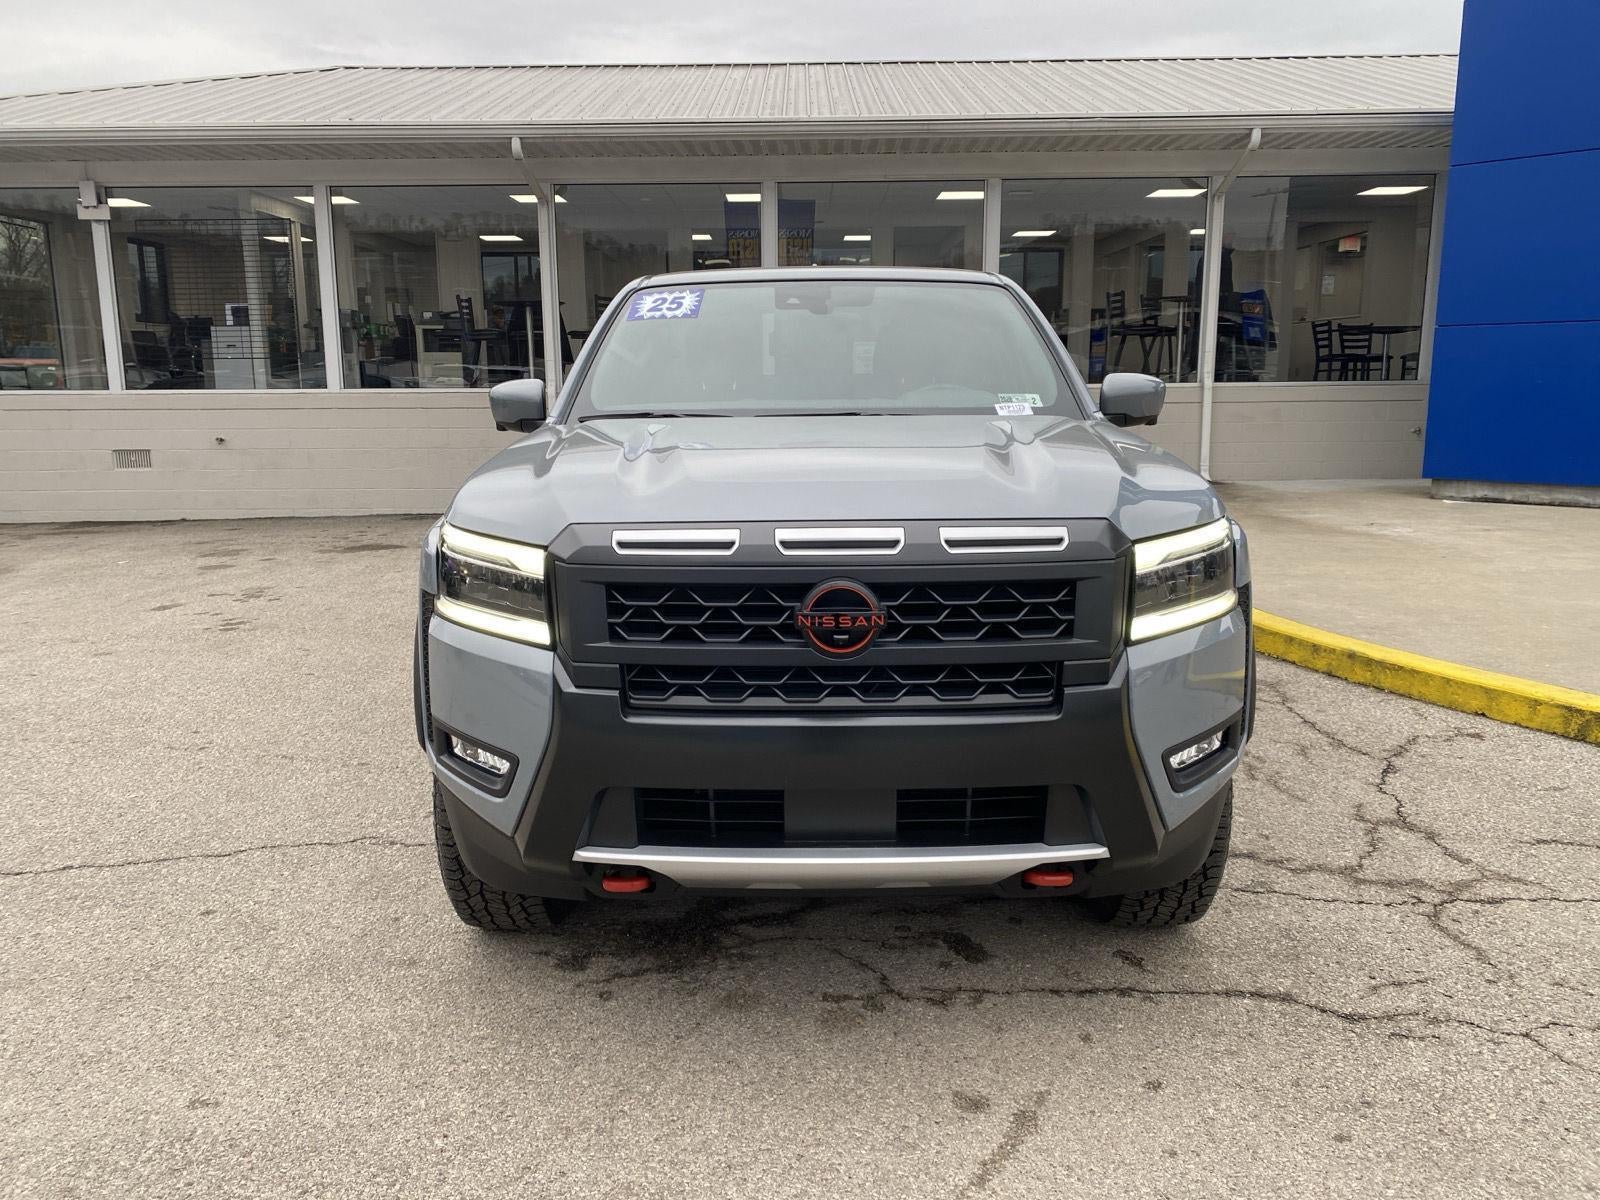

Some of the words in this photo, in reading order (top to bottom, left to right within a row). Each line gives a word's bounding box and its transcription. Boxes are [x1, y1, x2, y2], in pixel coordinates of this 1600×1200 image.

[646, 296, 686, 313] 25
[1031, 397, 1038, 405] 2
[797, 615, 885, 627] NISSAN
